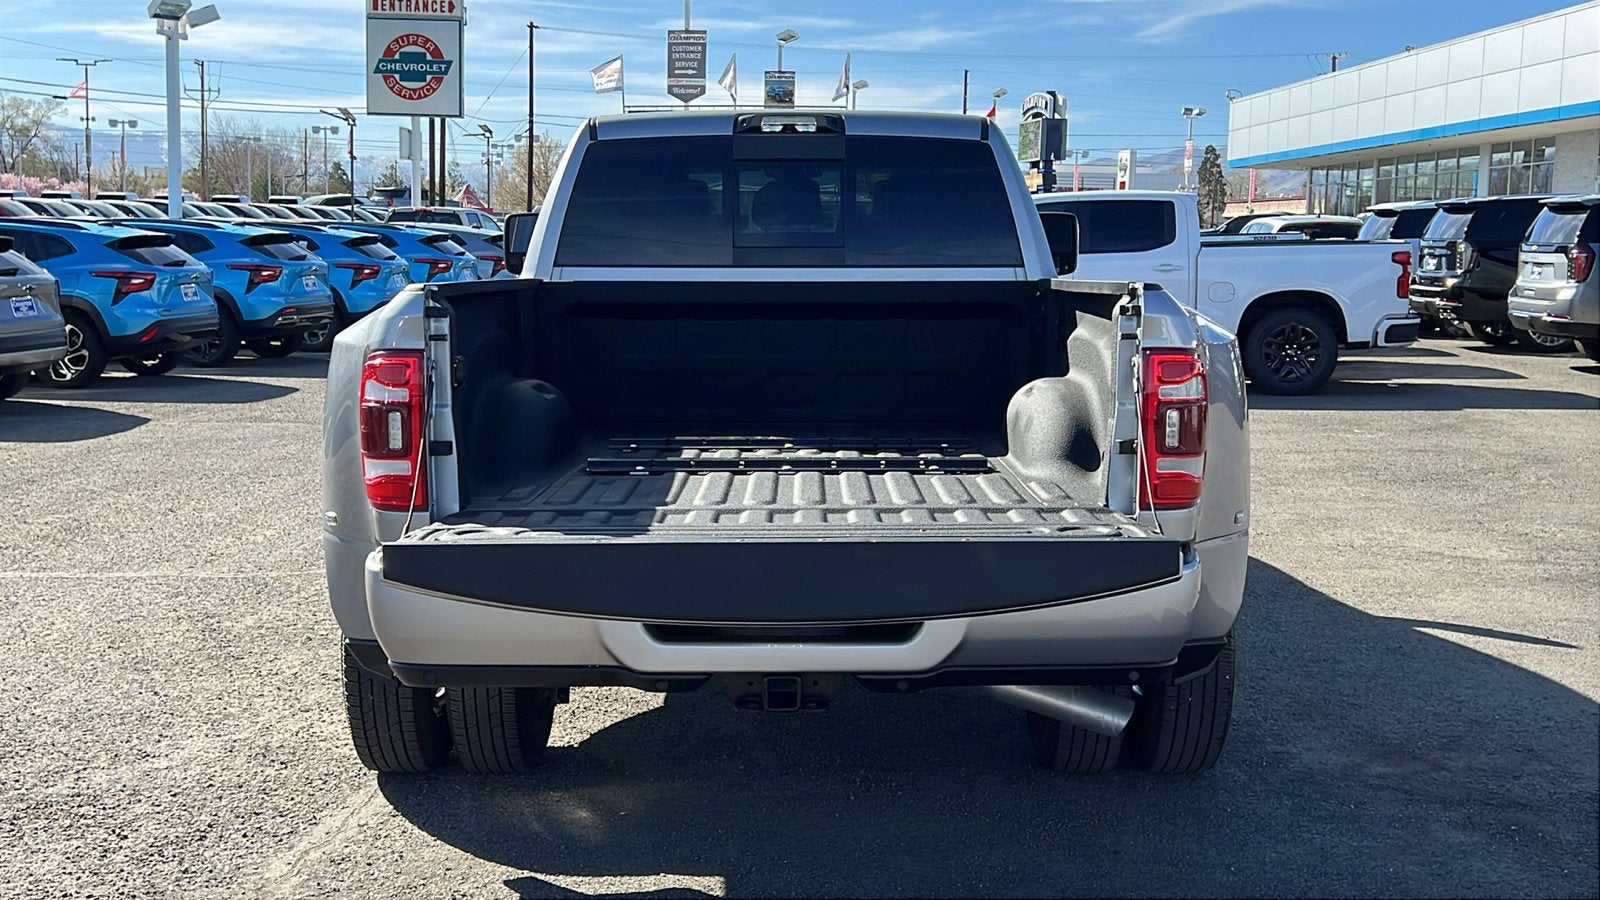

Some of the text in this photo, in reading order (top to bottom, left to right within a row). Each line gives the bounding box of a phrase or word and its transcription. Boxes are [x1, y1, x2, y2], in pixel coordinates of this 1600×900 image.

[381, 0, 446, 13] ENTRANCE
[390, 35, 436, 52] SUPER
[379, 62, 447, 72] CHEVROLET
[387, 77, 440, 99] SERVICE
